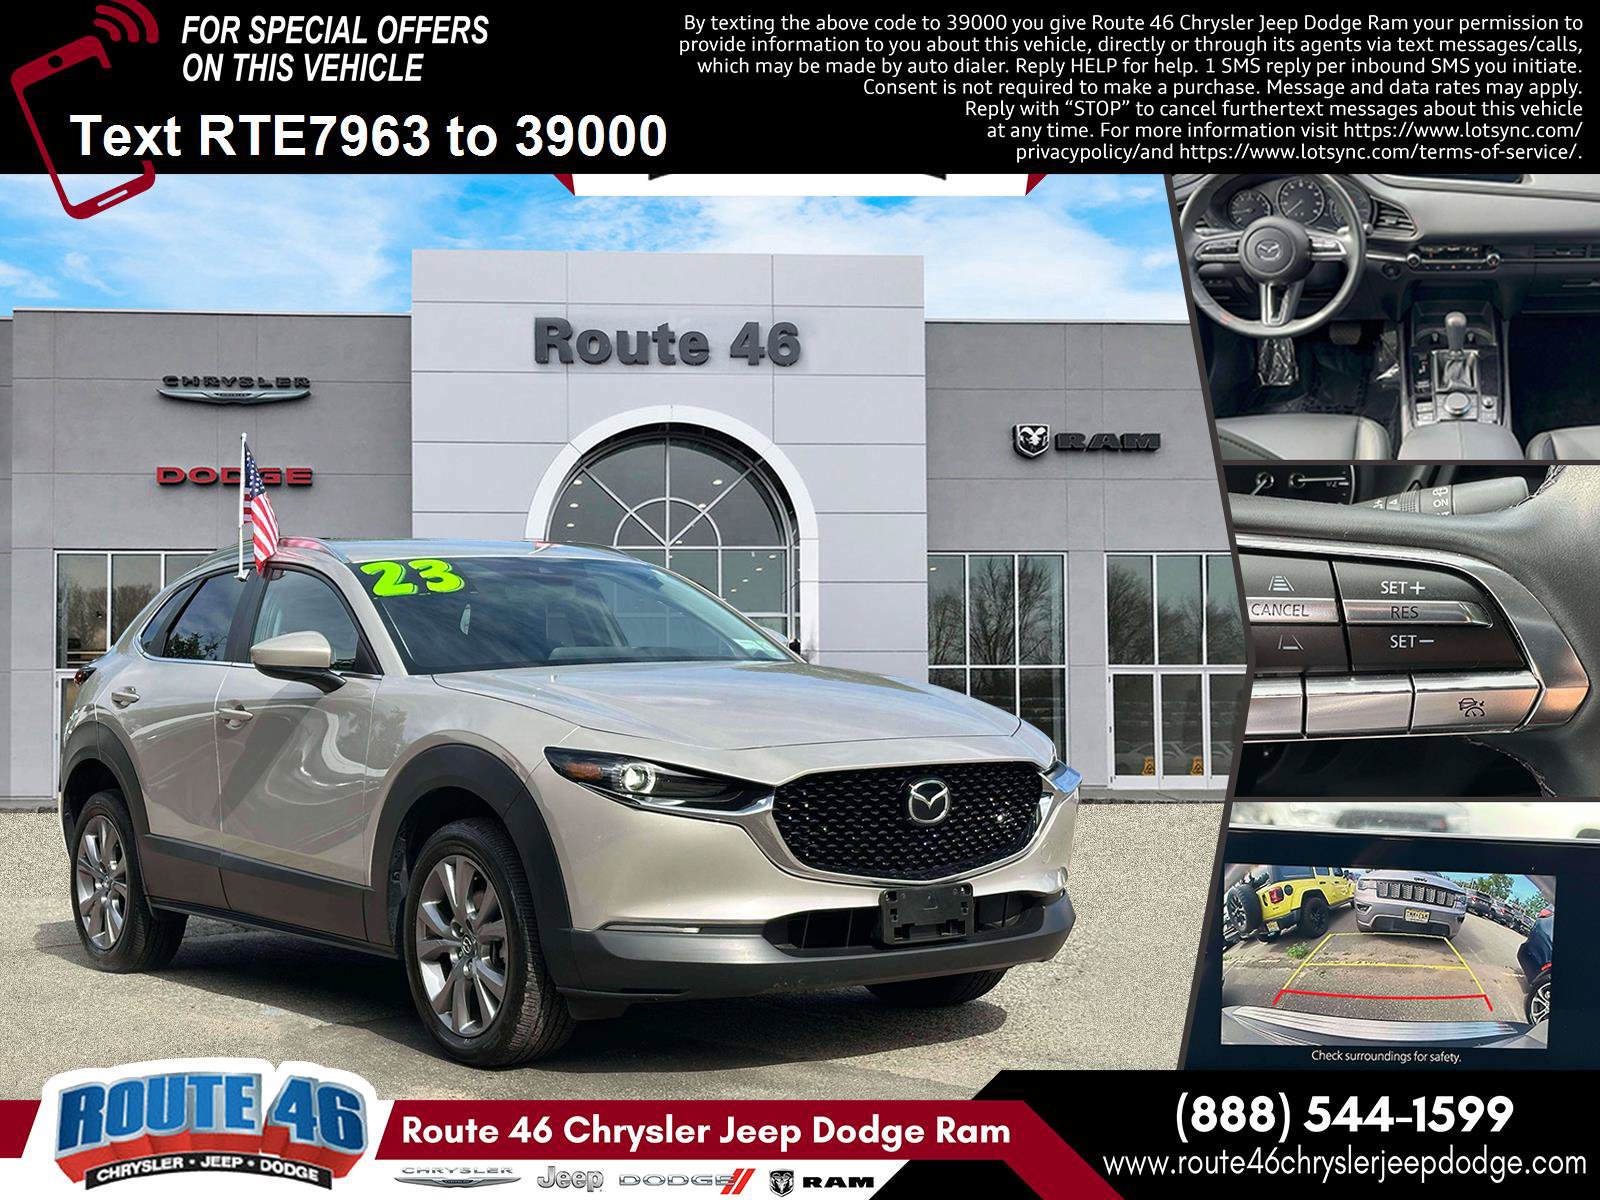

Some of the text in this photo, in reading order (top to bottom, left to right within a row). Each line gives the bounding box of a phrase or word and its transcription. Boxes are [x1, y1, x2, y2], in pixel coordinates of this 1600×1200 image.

[534, 316, 801, 367] Route 46
[162, 375, 311, 388] CHRYSLER
[1054, 432, 1162, 453] RAM
[156, 466, 313, 486] DODGE
[360, 558, 465, 597] 23
[1251, 604, 1310, 617] CANCEL
[1390, 606, 1419, 620] RES
[1311, 1049, 1462, 1065] Check surroundings for safety.
